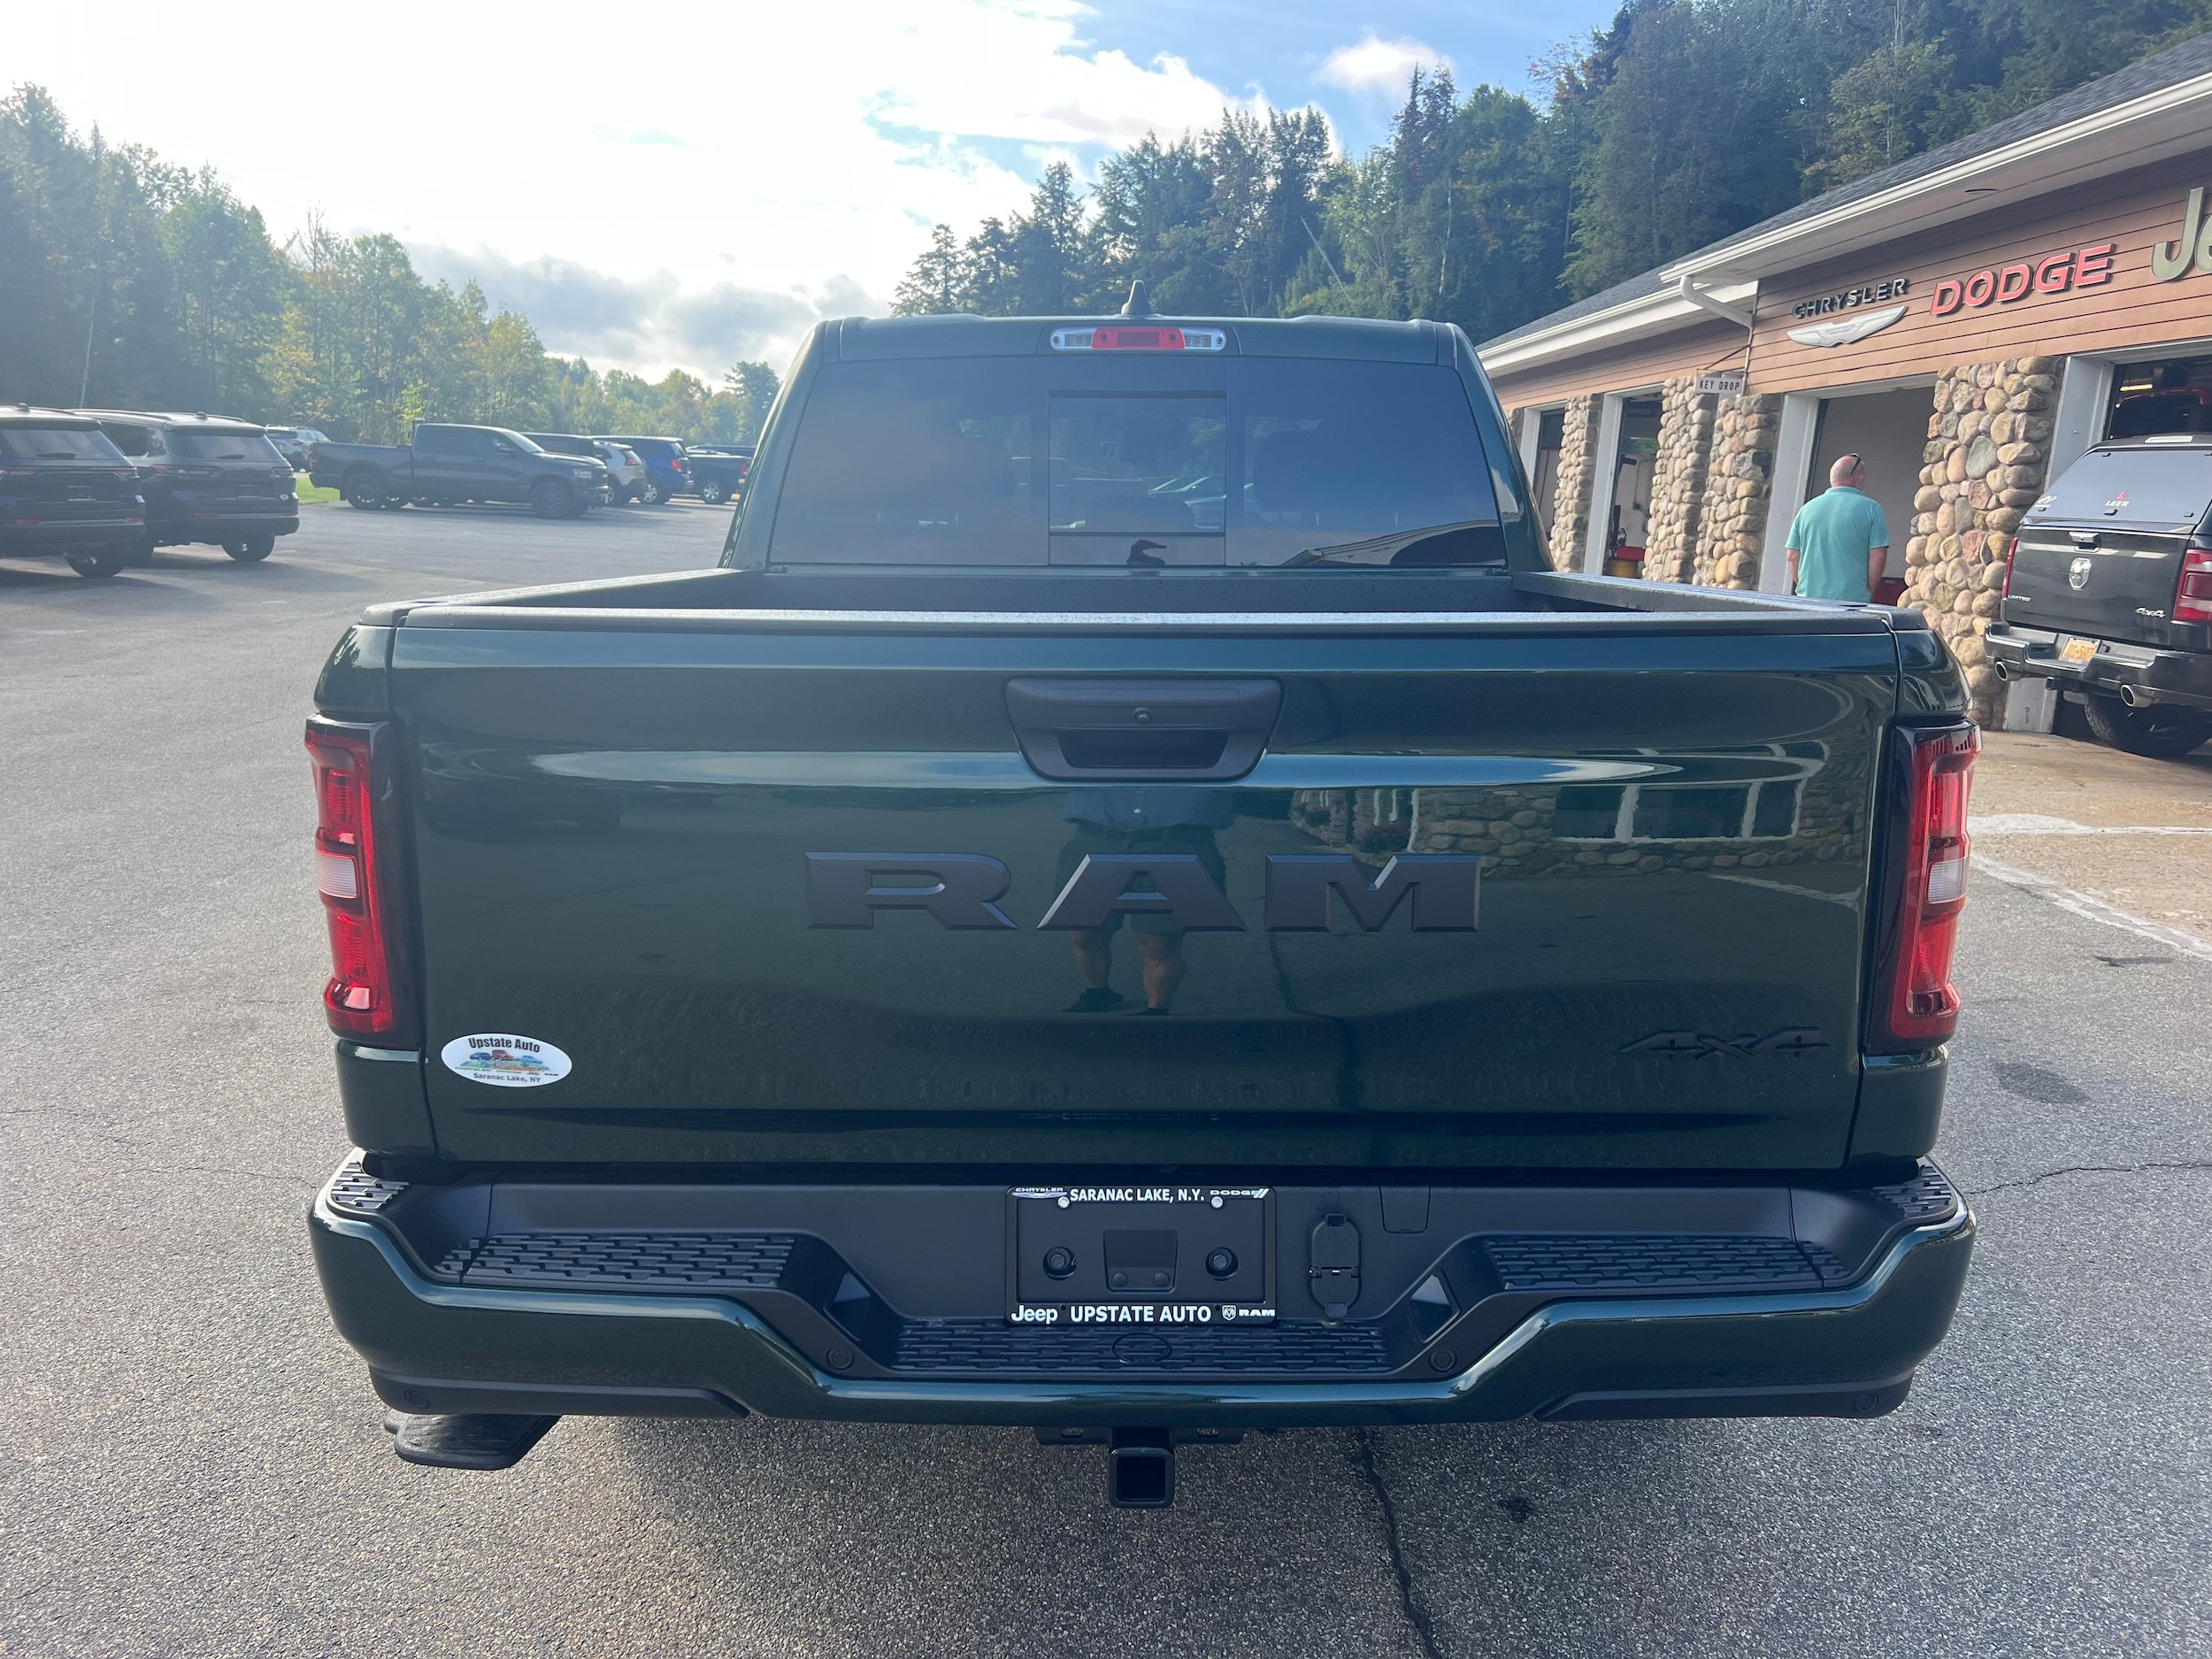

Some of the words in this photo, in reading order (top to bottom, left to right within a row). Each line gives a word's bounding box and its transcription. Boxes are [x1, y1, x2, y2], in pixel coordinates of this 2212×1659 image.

[1930, 242, 2115, 316] DODGE
[1792, 277, 1909, 319] CHRYSLER
[1699, 380, 1715, 389] KEY
[1718, 380, 1740, 391] DROP
[805, 852, 1481, 933] RAM
[468, 1037, 512, 1049] Upstate
[514, 1039, 541, 1053] Auto
[473, 1072, 505, 1081] Saranac
[1070, 1188, 1133, 1202] SARANAC
[1136, 1188, 1173, 1203] LAKE,
[1178, 1188, 1205, 1202] N.Y.
[1010, 1304, 1058, 1325] Jeep
[1070, 1305, 1155, 1323] UPSTATE
[1159, 1305, 1212, 1323] AUTO
